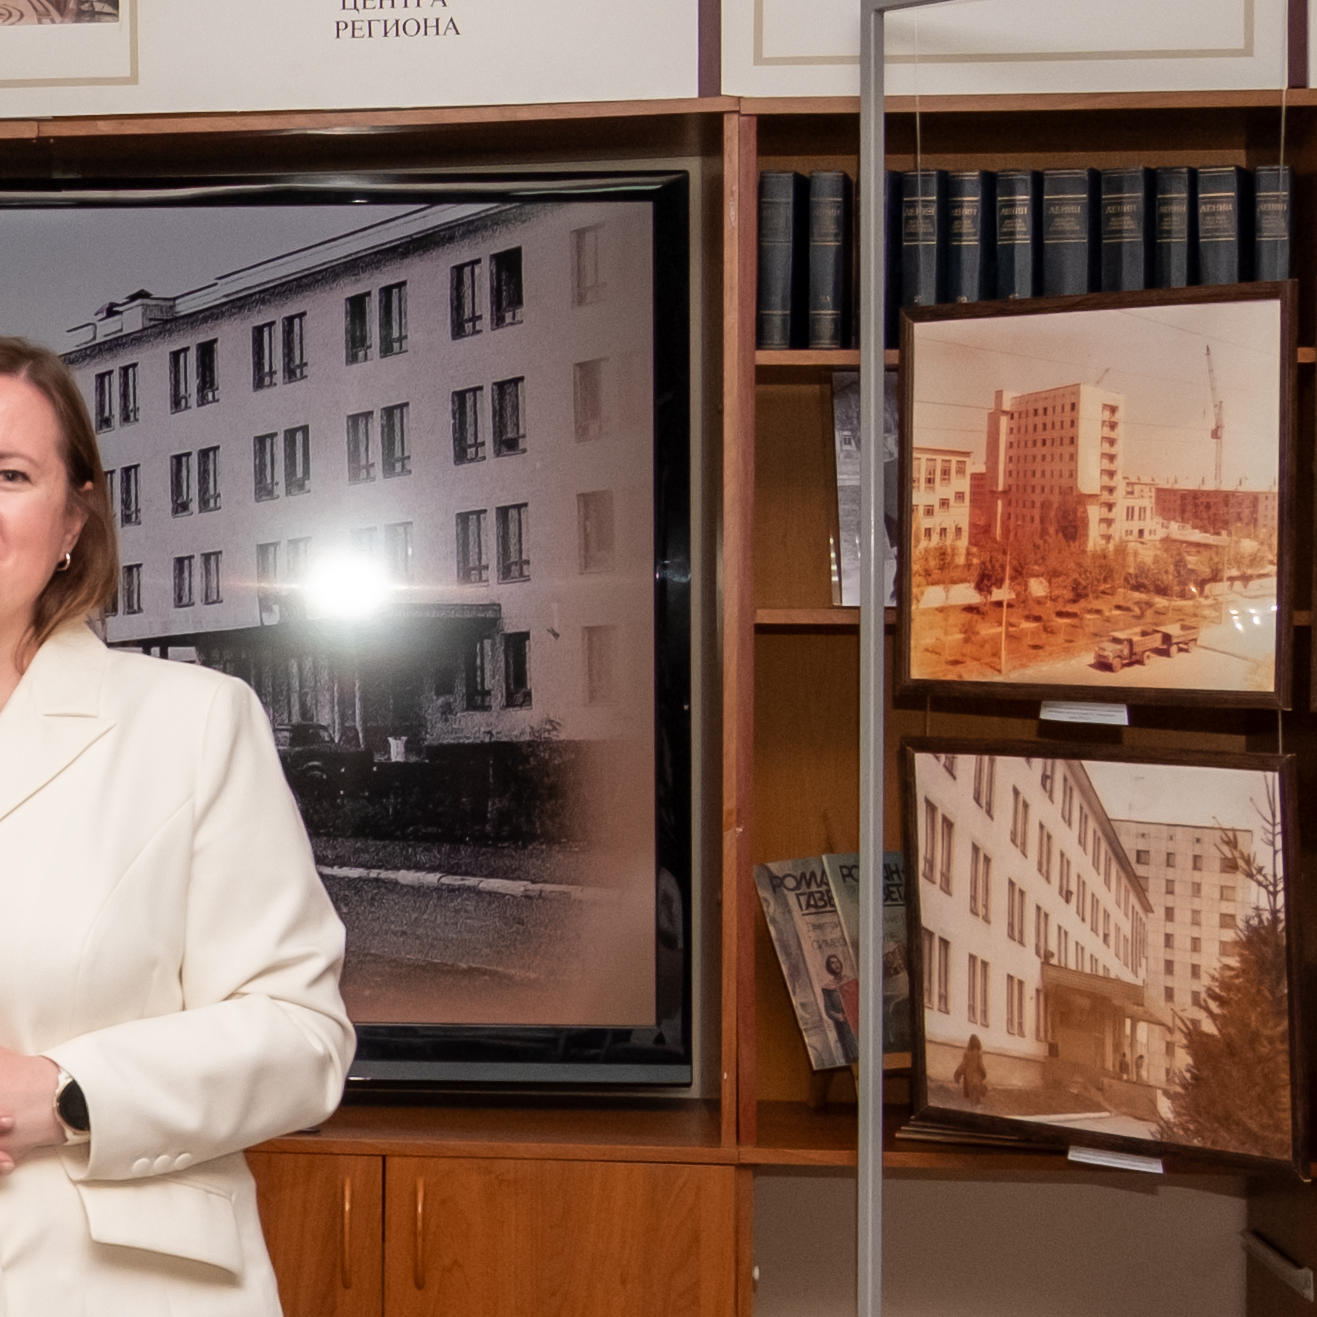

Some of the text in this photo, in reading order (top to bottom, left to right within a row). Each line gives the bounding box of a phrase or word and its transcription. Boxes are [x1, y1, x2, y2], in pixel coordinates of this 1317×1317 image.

[334, 16, 461, 39] РЕГИОНА
[768, 868, 831, 895] РОМА
[795, 889, 836, 912] ГАЗЕ
